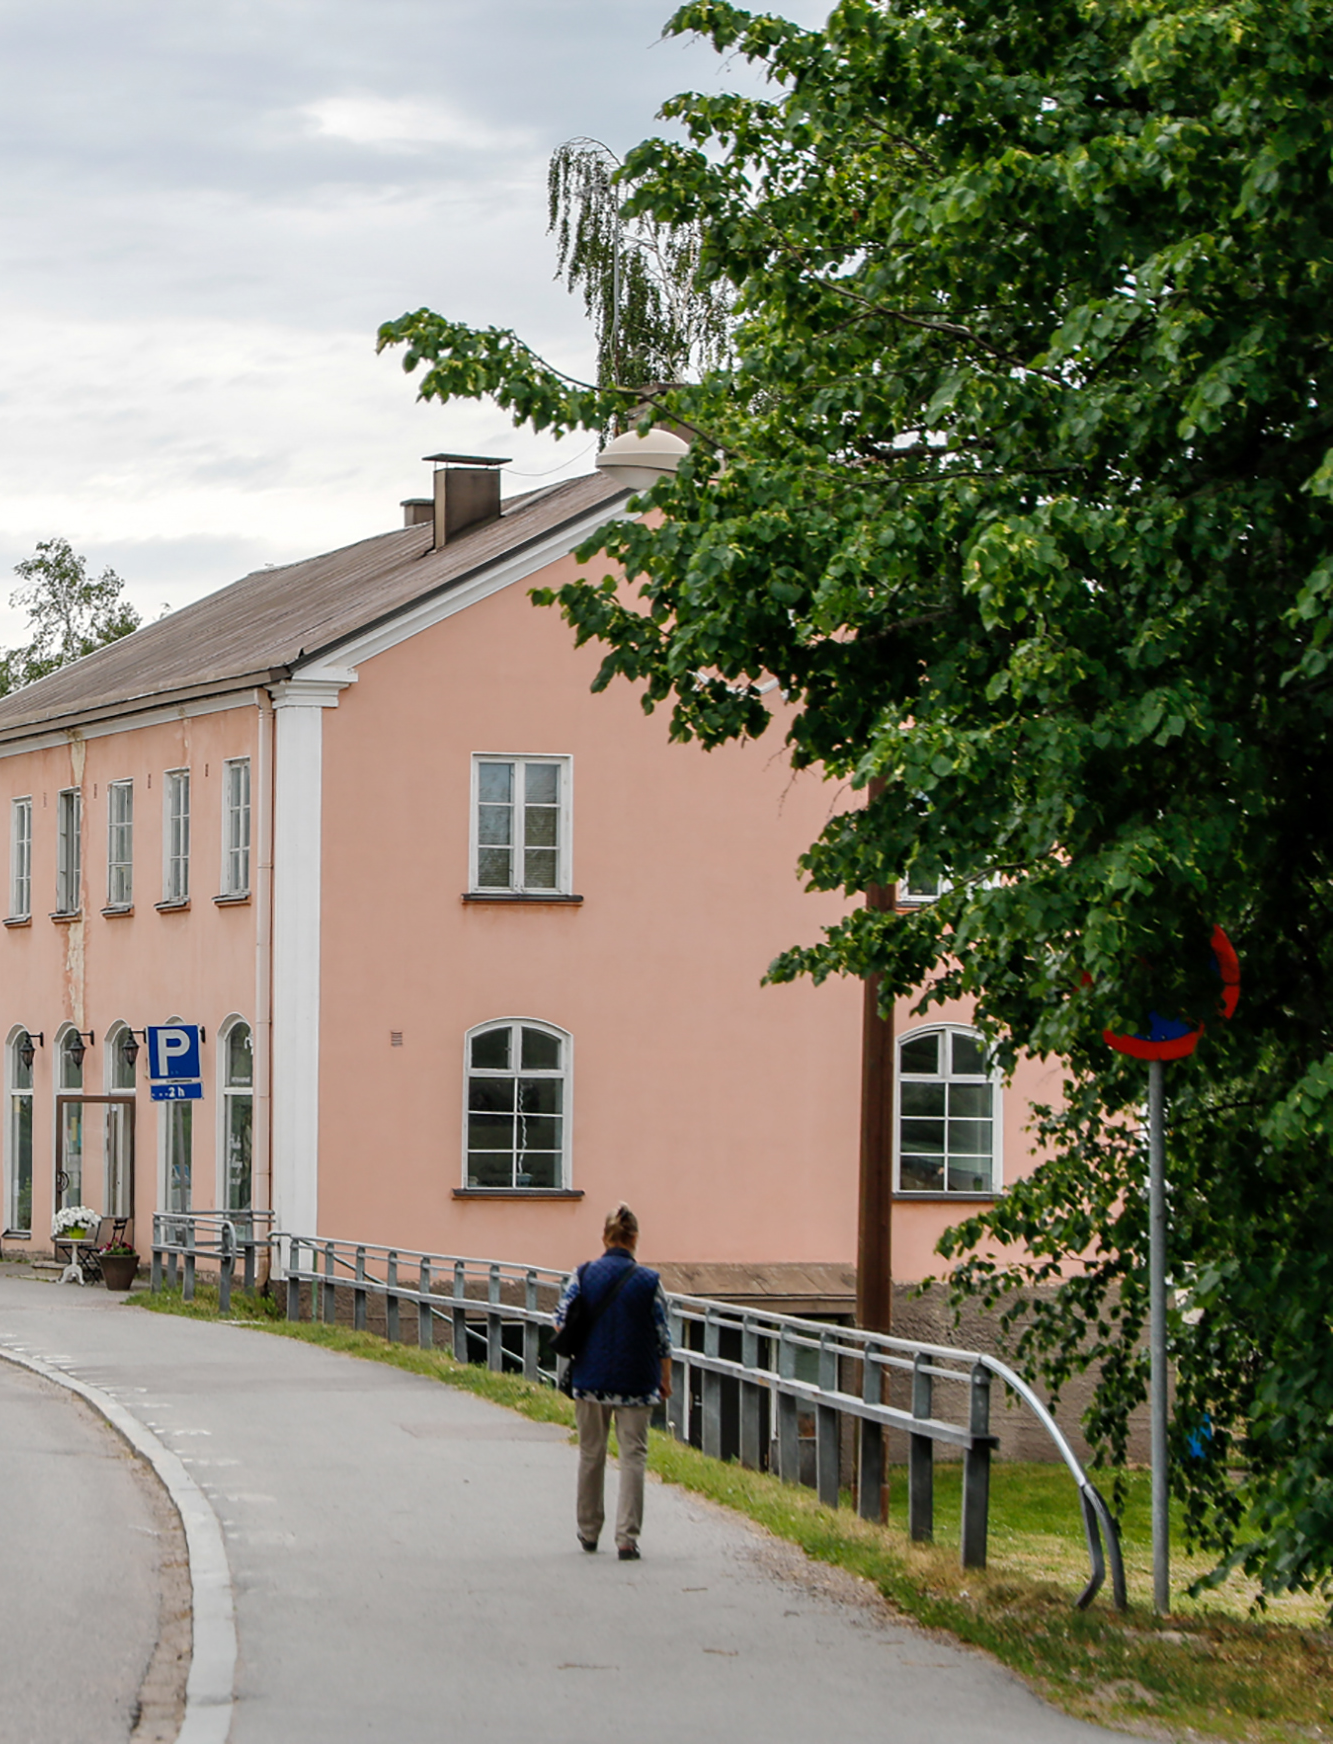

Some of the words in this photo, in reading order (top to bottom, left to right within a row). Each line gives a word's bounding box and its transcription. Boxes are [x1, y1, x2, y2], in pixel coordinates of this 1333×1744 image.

[157, 1029, 190, 1076] P
[168, 1086, 175, 1097] 2
[177, 1085, 185, 1097] h
